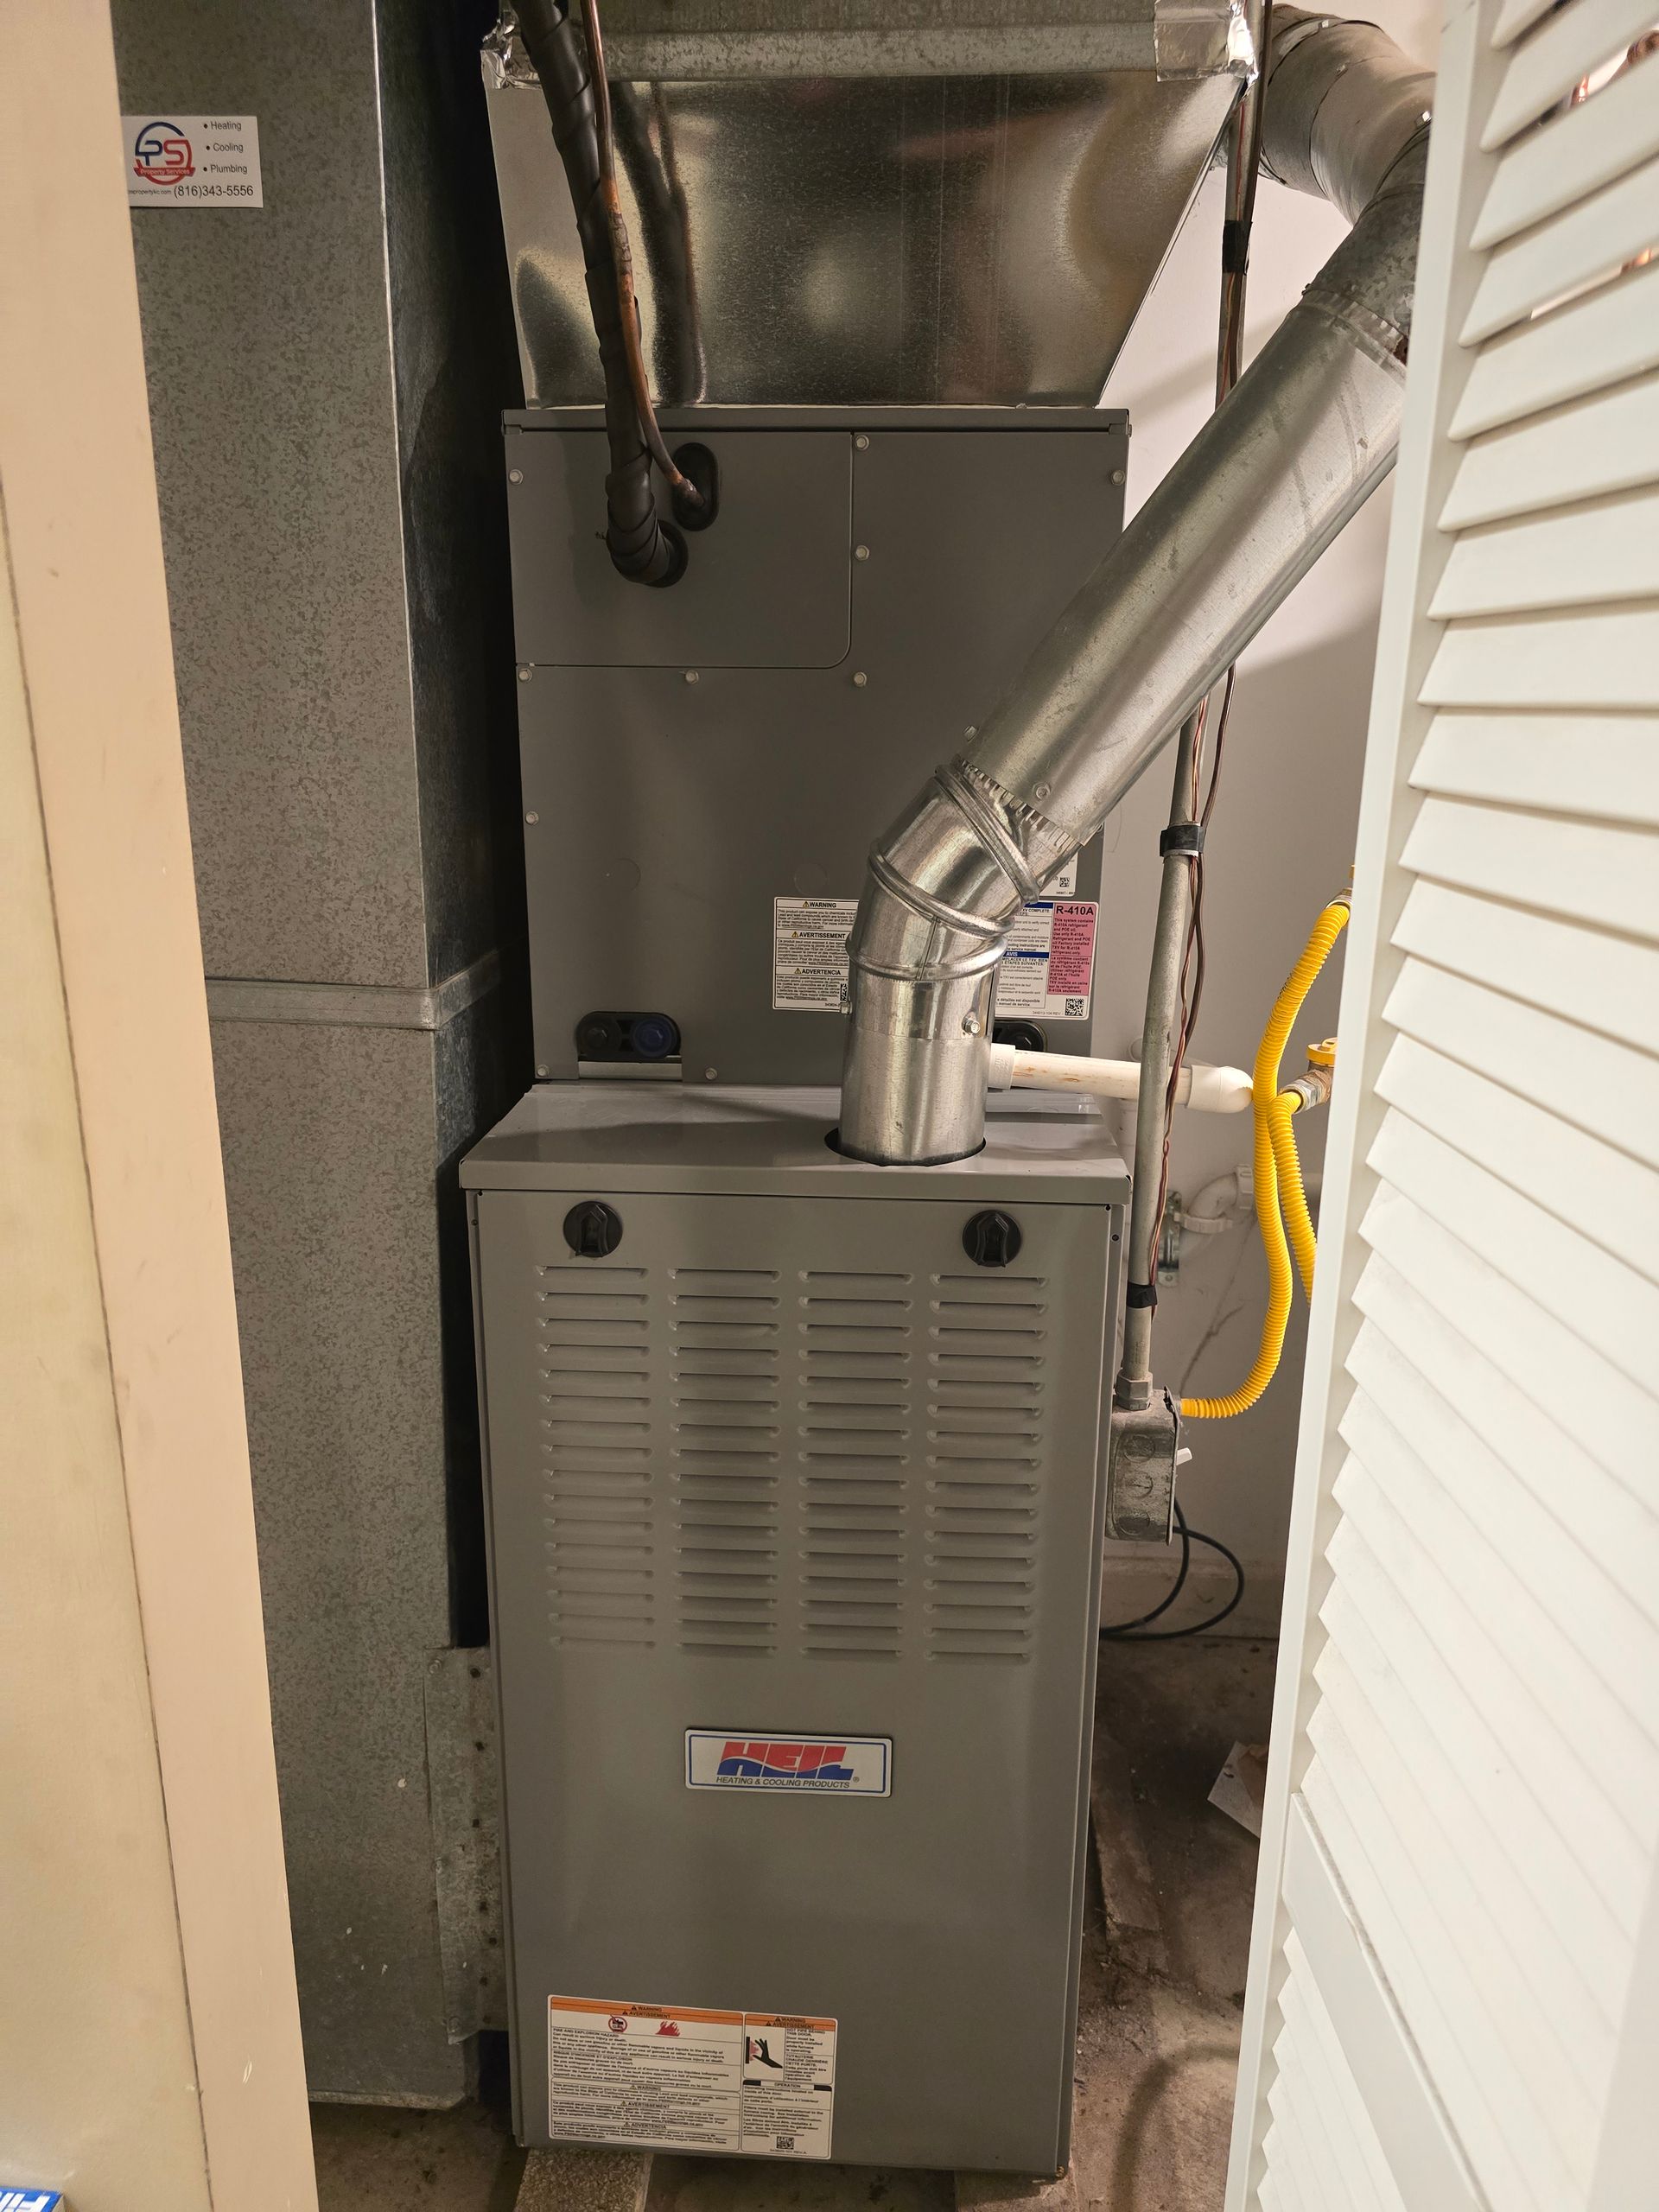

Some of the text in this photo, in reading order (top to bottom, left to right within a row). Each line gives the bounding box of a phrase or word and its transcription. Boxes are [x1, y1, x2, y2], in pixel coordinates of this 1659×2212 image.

[210, 121, 242, 131] Heating
[213, 143, 243, 153] Cooling
[210, 165, 248, 175] Plumbing
[174, 185, 254, 199] (816)343-5556
[1056, 906, 1093, 915] R-410A
[717, 1742, 854, 1780] HEIL
[716, 1777, 753, 1785] HEATING
